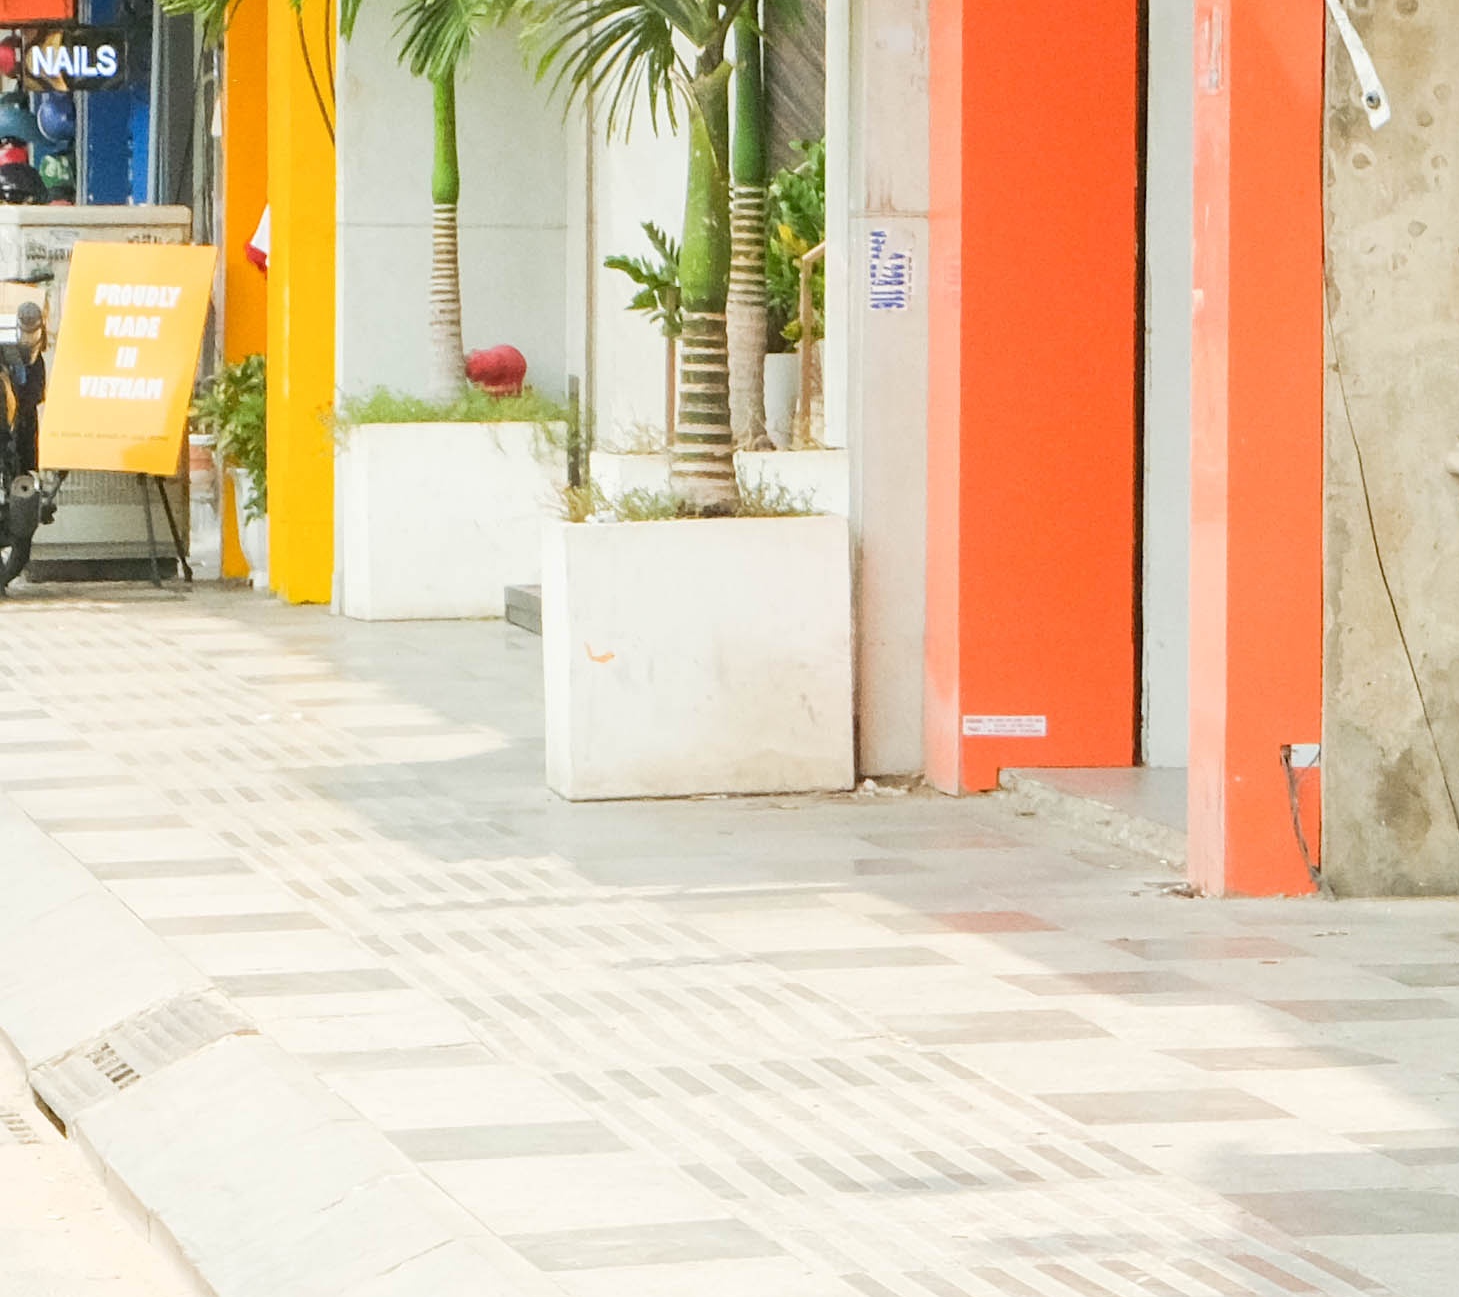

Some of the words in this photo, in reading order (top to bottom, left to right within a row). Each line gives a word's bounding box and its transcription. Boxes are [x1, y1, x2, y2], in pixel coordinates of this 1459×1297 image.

[30, 45, 118, 78] NAILS
[93, 282, 182, 309] PROUDLY
[103, 314, 162, 340] MADE
[115, 346, 139, 368] IN
[78, 375, 165, 400] VIETNAM
